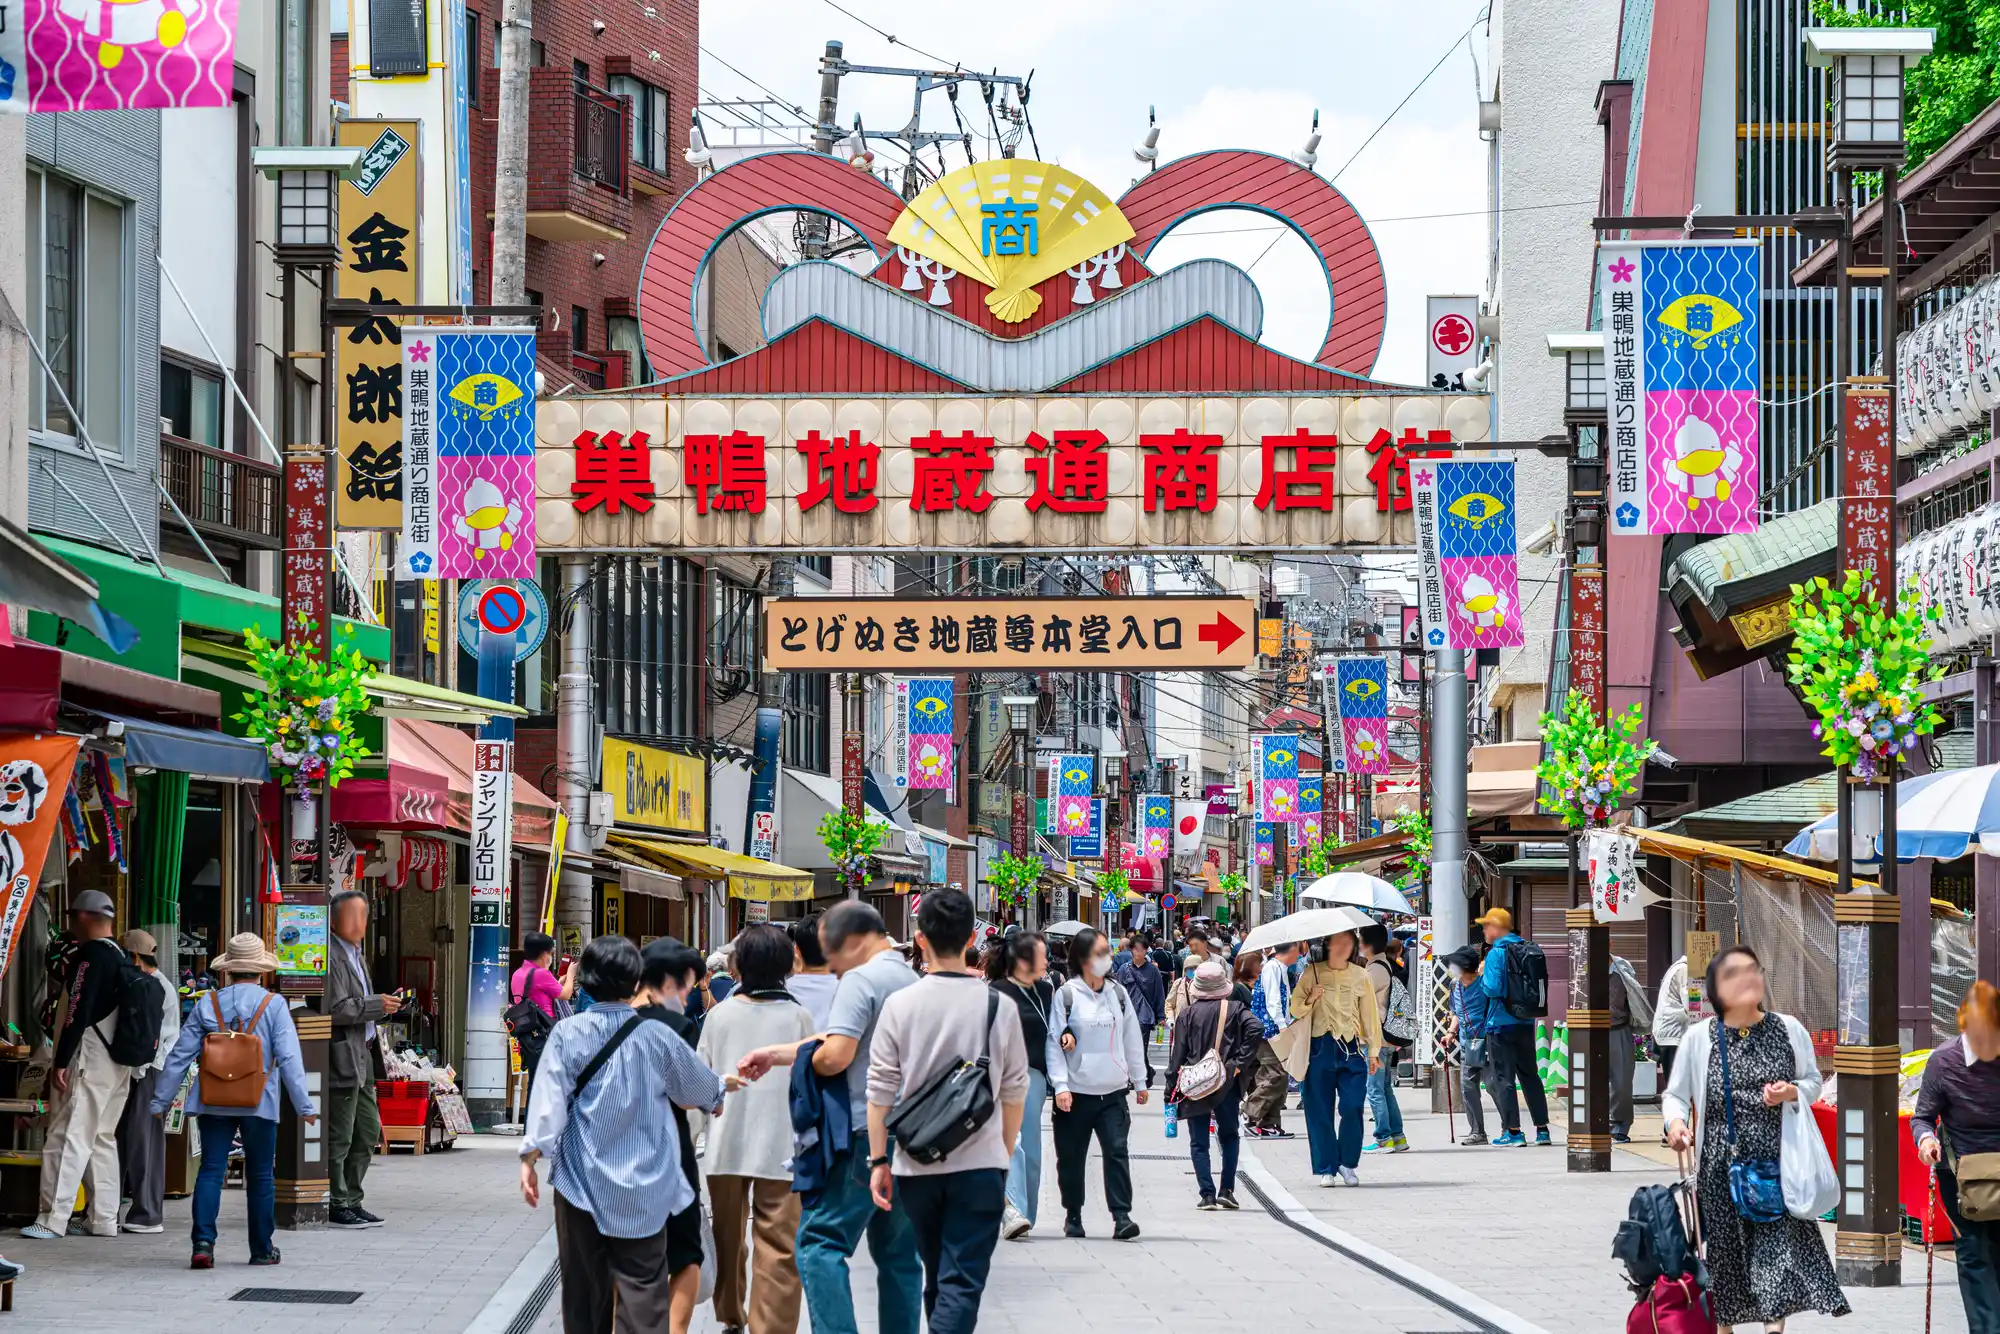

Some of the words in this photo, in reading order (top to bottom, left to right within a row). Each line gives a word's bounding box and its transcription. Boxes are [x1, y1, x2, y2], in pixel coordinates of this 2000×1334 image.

[980, 196, 1039, 257] 商
[1686, 303, 1715, 333] 商
[347, 212, 409, 502] 金太郎飴
[473, 380, 498, 407] 商
[1612, 291, 1637, 493] 巣鴨地蔵通り商店街
[410, 369, 429, 543] 巣鴨地蔵通り商店街
[571, 428, 1452, 515] 巣鴨地蔵通商店街
[1466, 498, 1486, 519] 商
[1417, 491, 1442, 623] 巣鴨地蔵通り商店街
[780, 615, 1183, 654] とげぬき地蔵尊本堂入口
[925, 700, 937, 713] 商
[1326, 677, 1343, 756] 巣鴨地蔵通り商店街
[897, 694, 906, 773] 巣鴨地蔵通り商店街
[477, 744, 486, 770] マンション
[475, 773, 497, 881] シャンブル石山
[1607, 841, 1618, 866] 名物
[473, 905, 495, 913] 巣鴨
[481, 887, 501, 895] この先
[473, 914, 493, 922] 3-17
